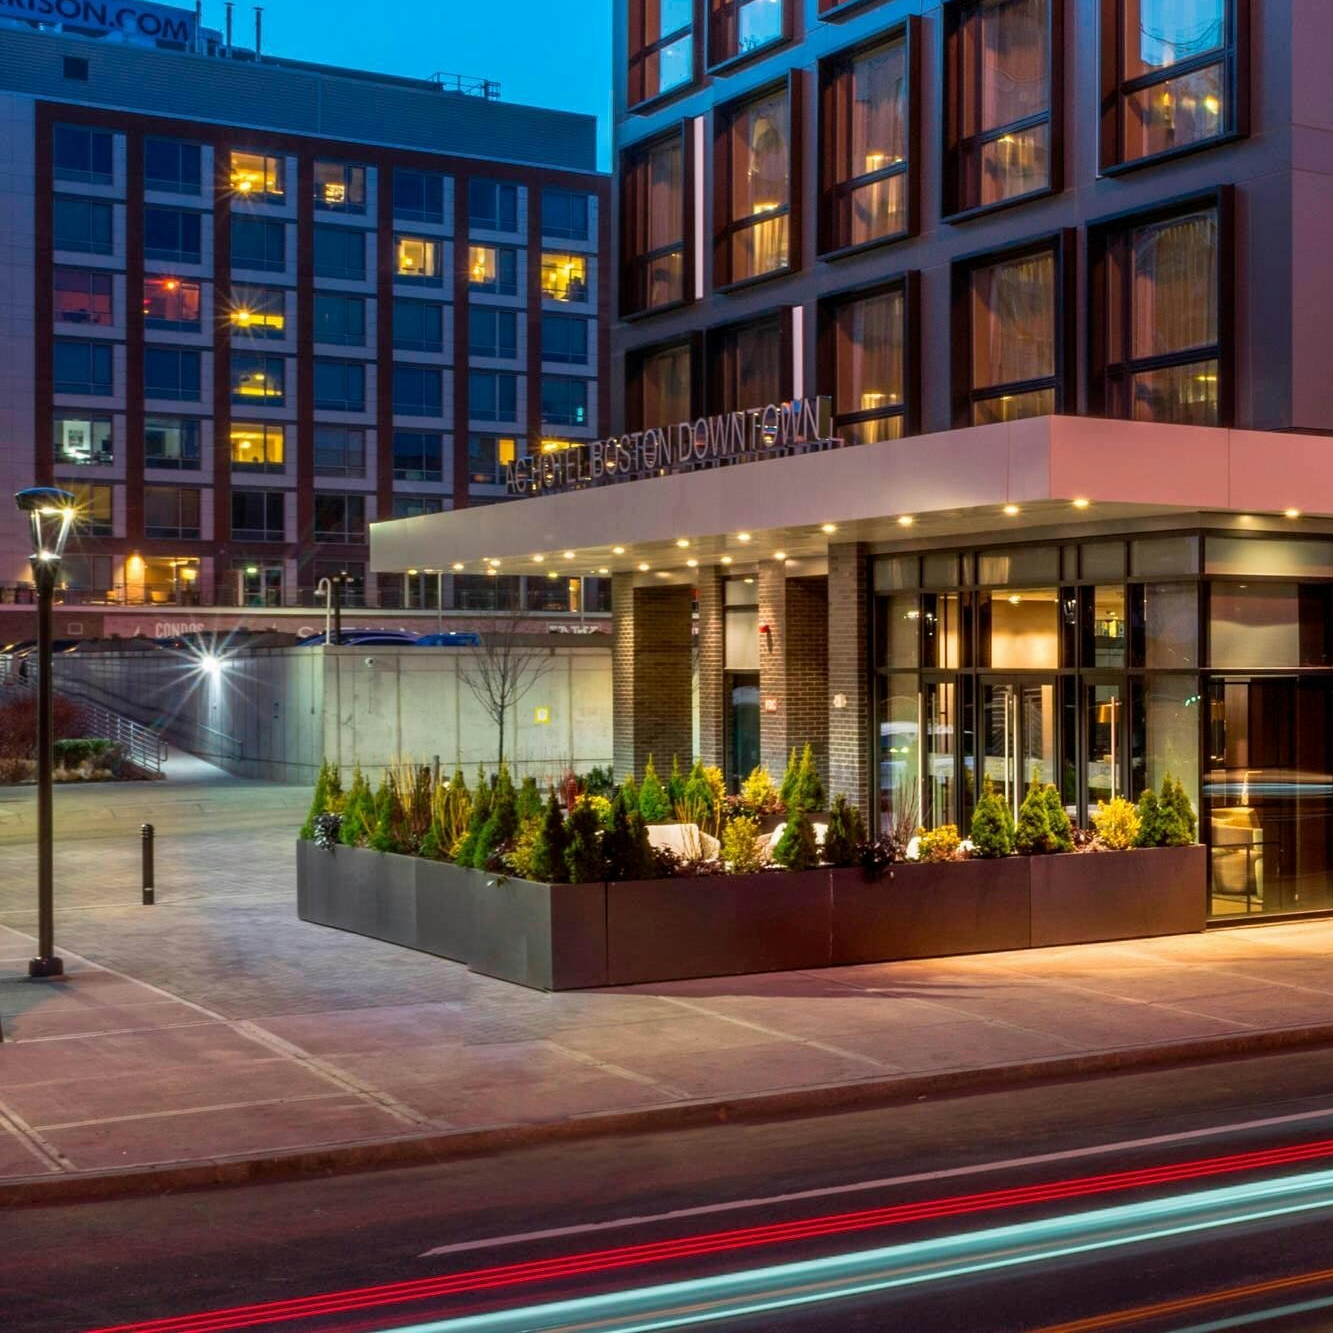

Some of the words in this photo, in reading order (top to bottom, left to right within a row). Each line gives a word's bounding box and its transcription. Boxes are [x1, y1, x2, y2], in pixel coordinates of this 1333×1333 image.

[506, 458, 527, 494] AC
[531, 444, 591, 491] HOTEL
[591, 425, 672, 479] BOSTON
[679, 396, 820, 463] DOWNTOWN
